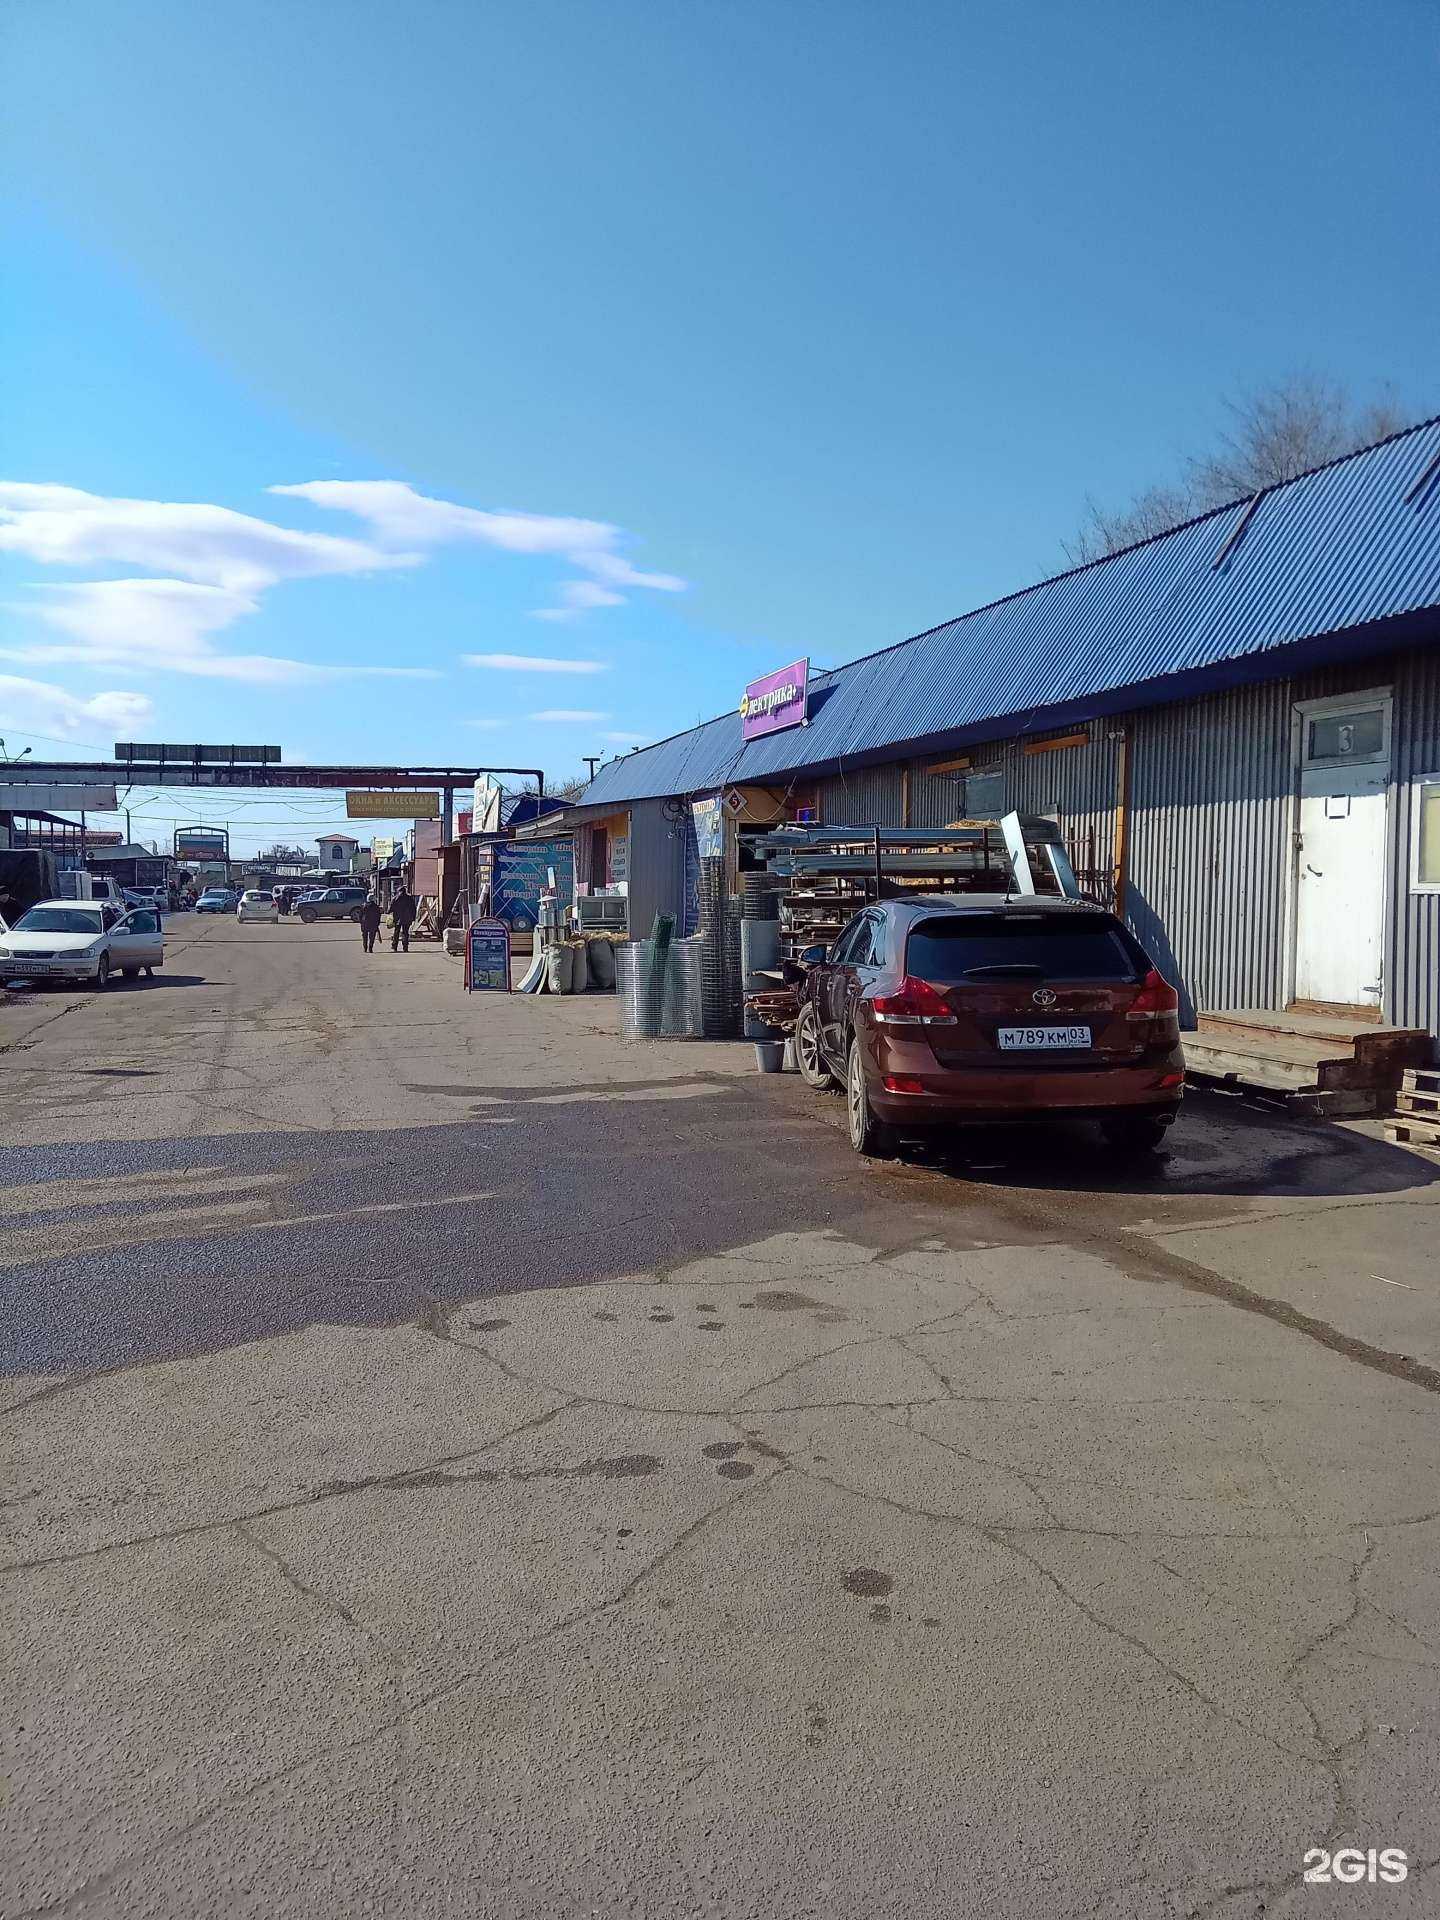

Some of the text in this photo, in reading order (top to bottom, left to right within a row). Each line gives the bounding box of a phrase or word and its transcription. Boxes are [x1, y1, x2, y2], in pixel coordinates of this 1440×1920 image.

[1339, 726, 1354, 753] 3
[732, 798, 738, 806] 5
[1070, 1028, 1085, 1040] 03
